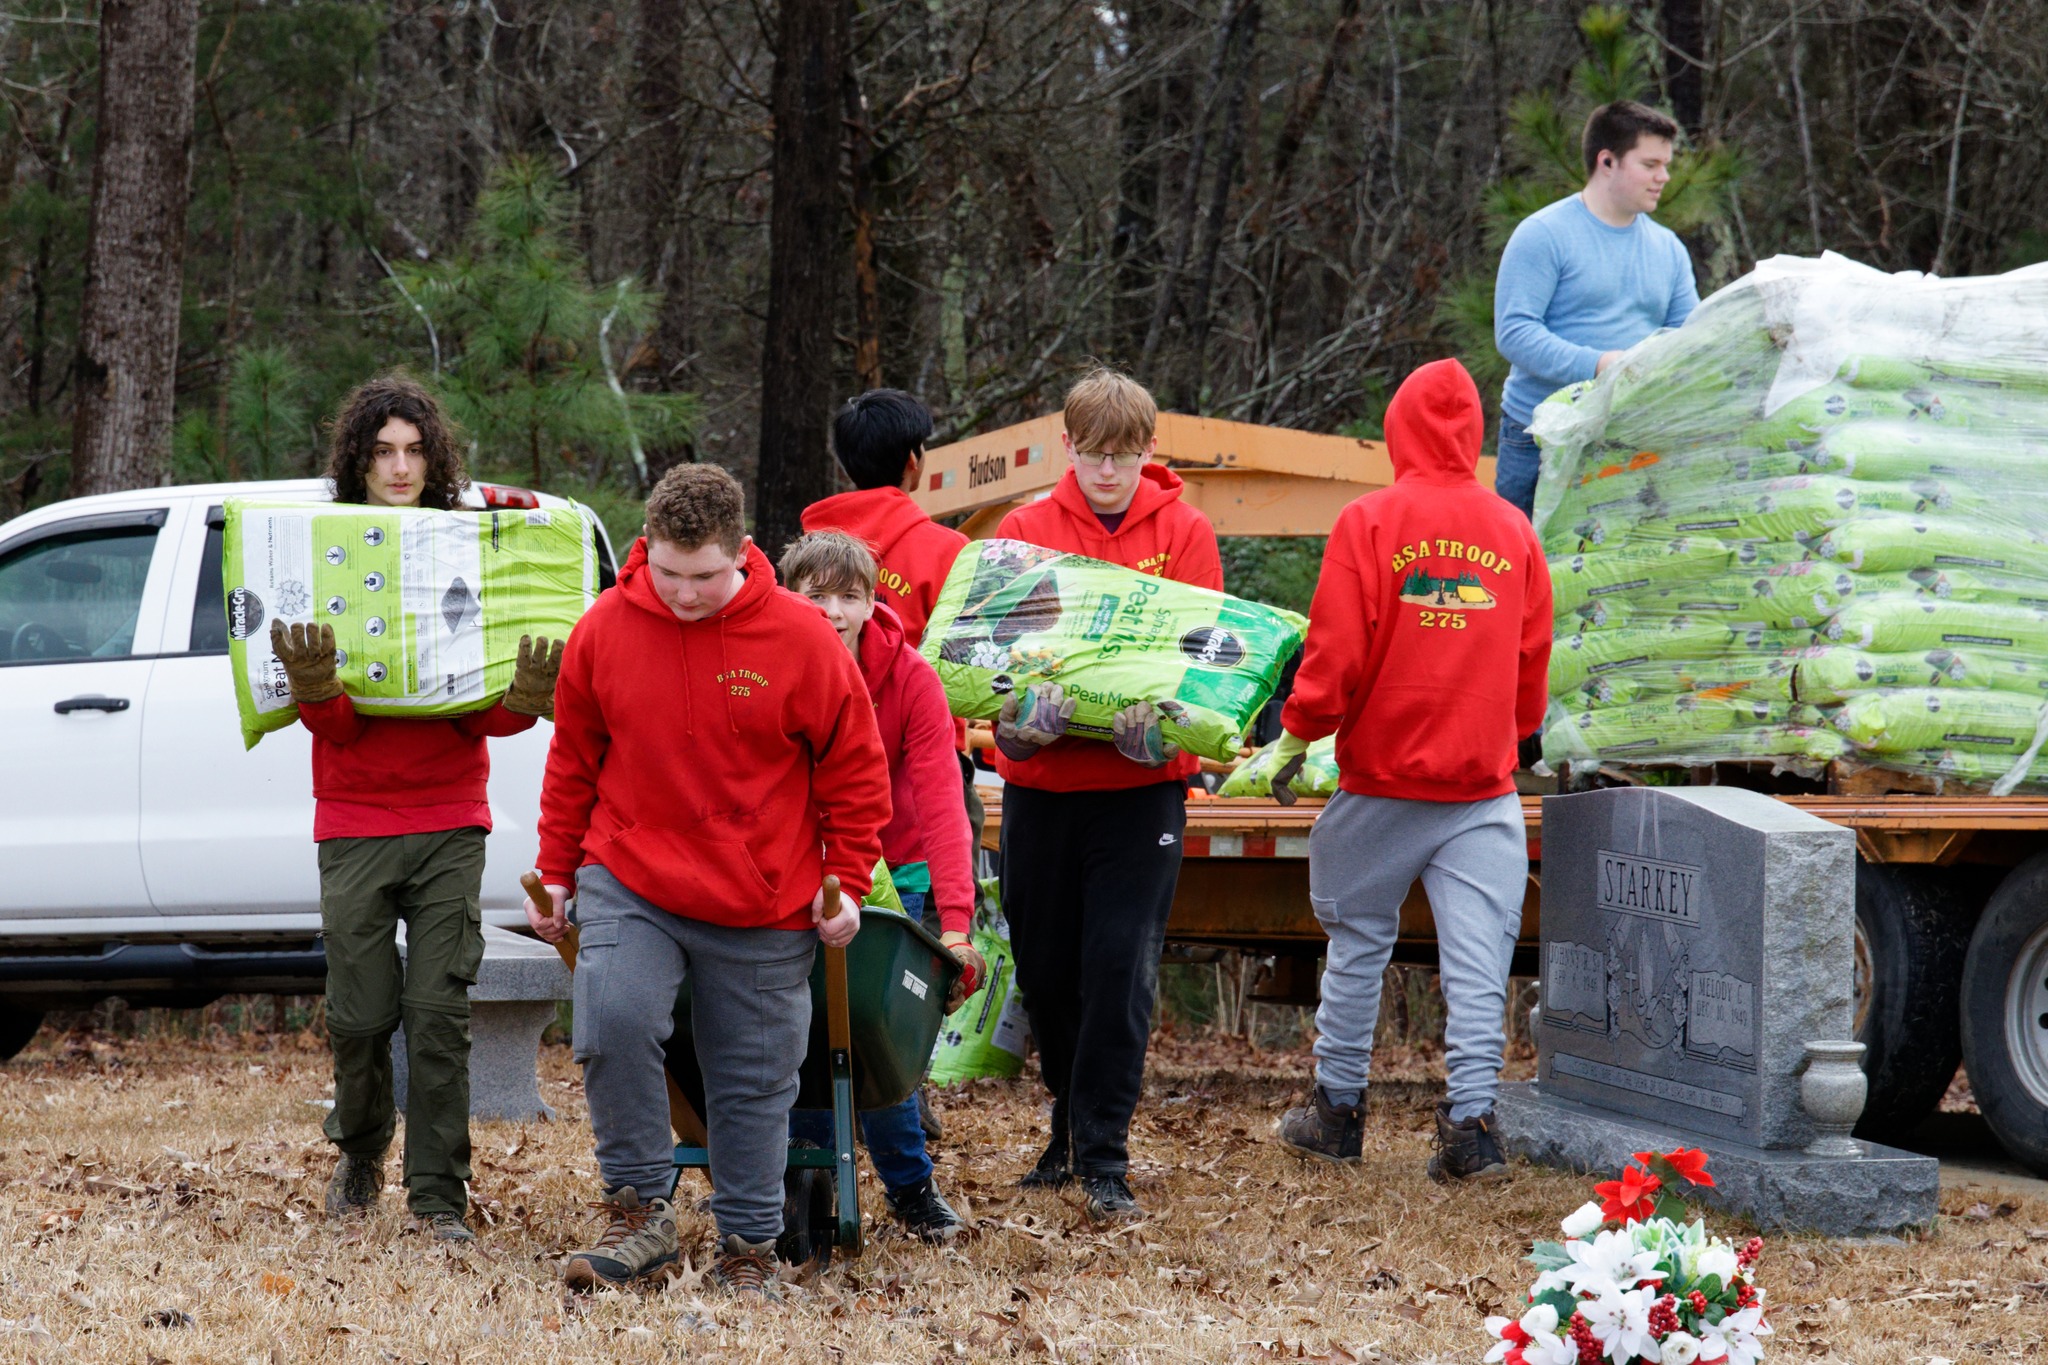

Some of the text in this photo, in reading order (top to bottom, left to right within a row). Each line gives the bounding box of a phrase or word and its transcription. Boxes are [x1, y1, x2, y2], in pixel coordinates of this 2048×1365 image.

[968, 453, 1007, 489] Hudson
[1391, 538, 1513, 576] BSA TROOP
[878, 567, 912, 598] OOP
[1119, 579, 1160, 626] Peat
[1418, 610, 1468, 630] 275
[273, 666, 291, 698] Peat
[730, 685, 751, 697] 275
[738, 668, 769, 688] TROOP
[1069, 683, 1139, 709] Peat Mos
[1604, 858, 1693, 917] STARKEY
[1698, 977, 1733, 1003] MELODY
